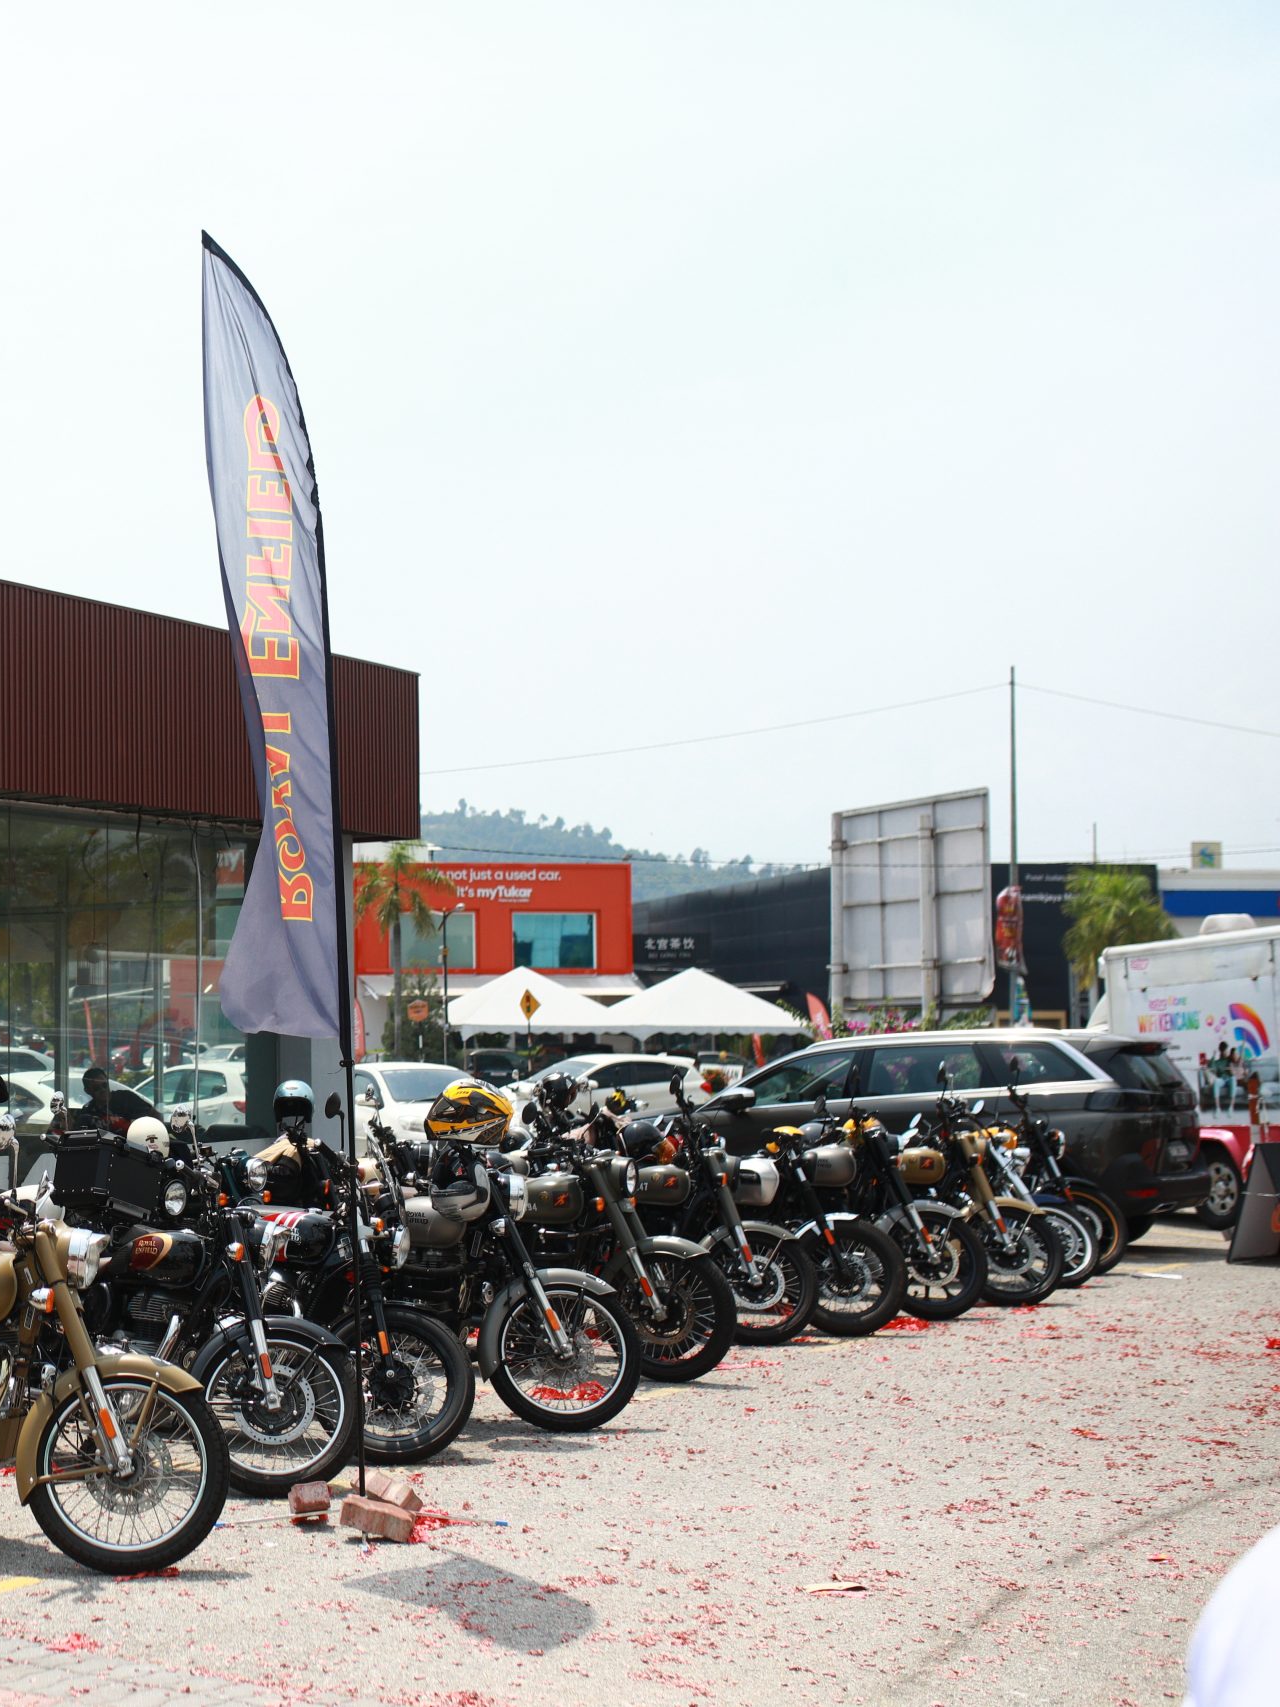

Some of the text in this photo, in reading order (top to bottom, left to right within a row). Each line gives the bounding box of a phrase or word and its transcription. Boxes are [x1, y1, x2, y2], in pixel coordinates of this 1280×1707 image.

[446, 870, 467, 880] not
[469, 868, 492, 883] just
[494, 871, 503, 880] a
[506, 868, 536, 880] used
[538, 870, 562, 881] car.
[477, 884, 532, 900] myTukar
[135, 1247, 158, 1255] ENFIELD
